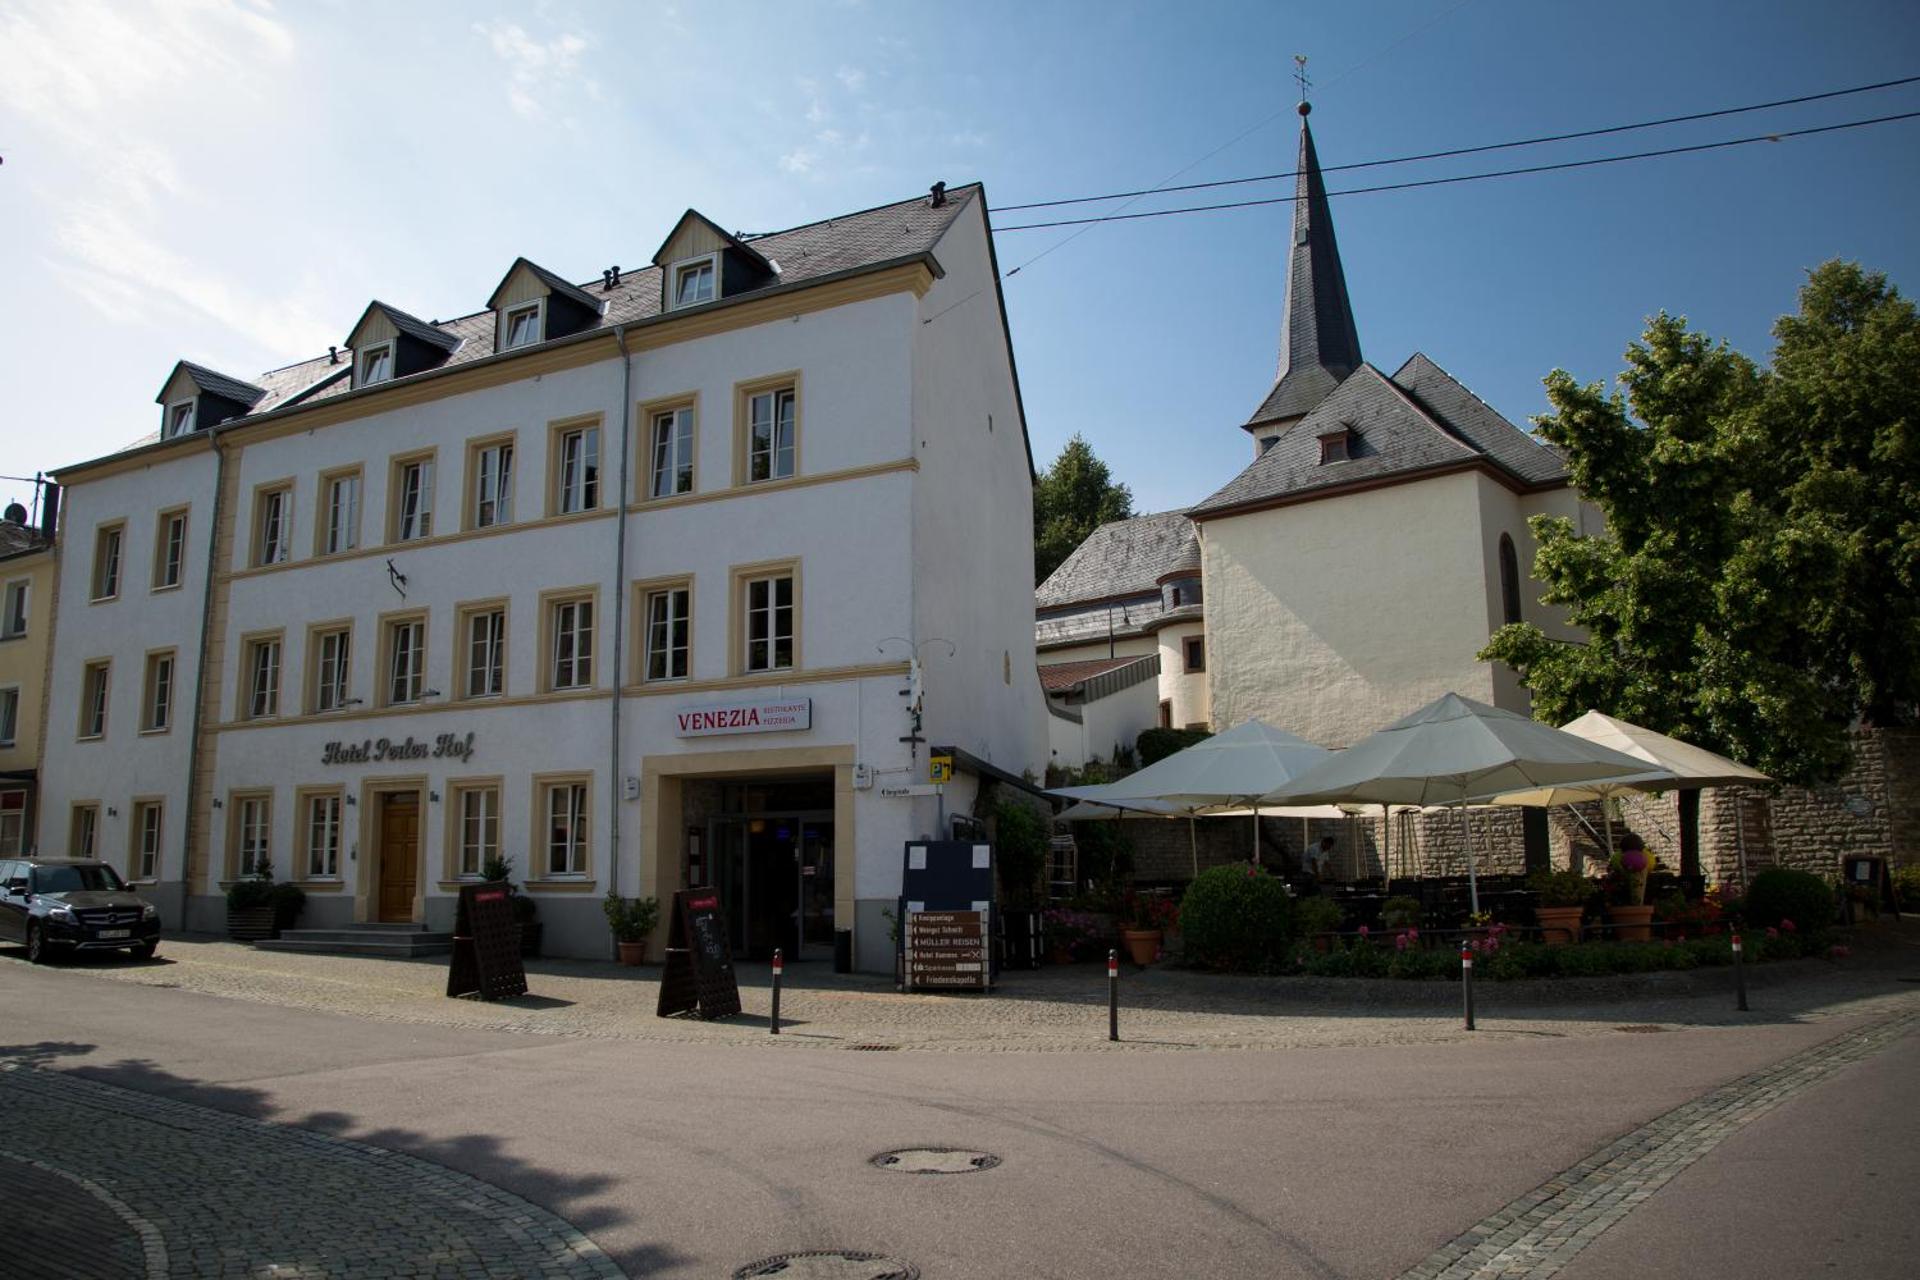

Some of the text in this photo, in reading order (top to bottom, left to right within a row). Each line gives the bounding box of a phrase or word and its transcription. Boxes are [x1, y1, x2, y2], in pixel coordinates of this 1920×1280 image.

[678, 708, 760, 731] VENEZIA
[764, 716, 796, 726] PIZZERIA
[321, 732, 475, 765] Hotel Perler Hof
[919, 937, 980, 946] MÜLLER REISEN
[926, 975, 976, 985] Friedenskapelle
